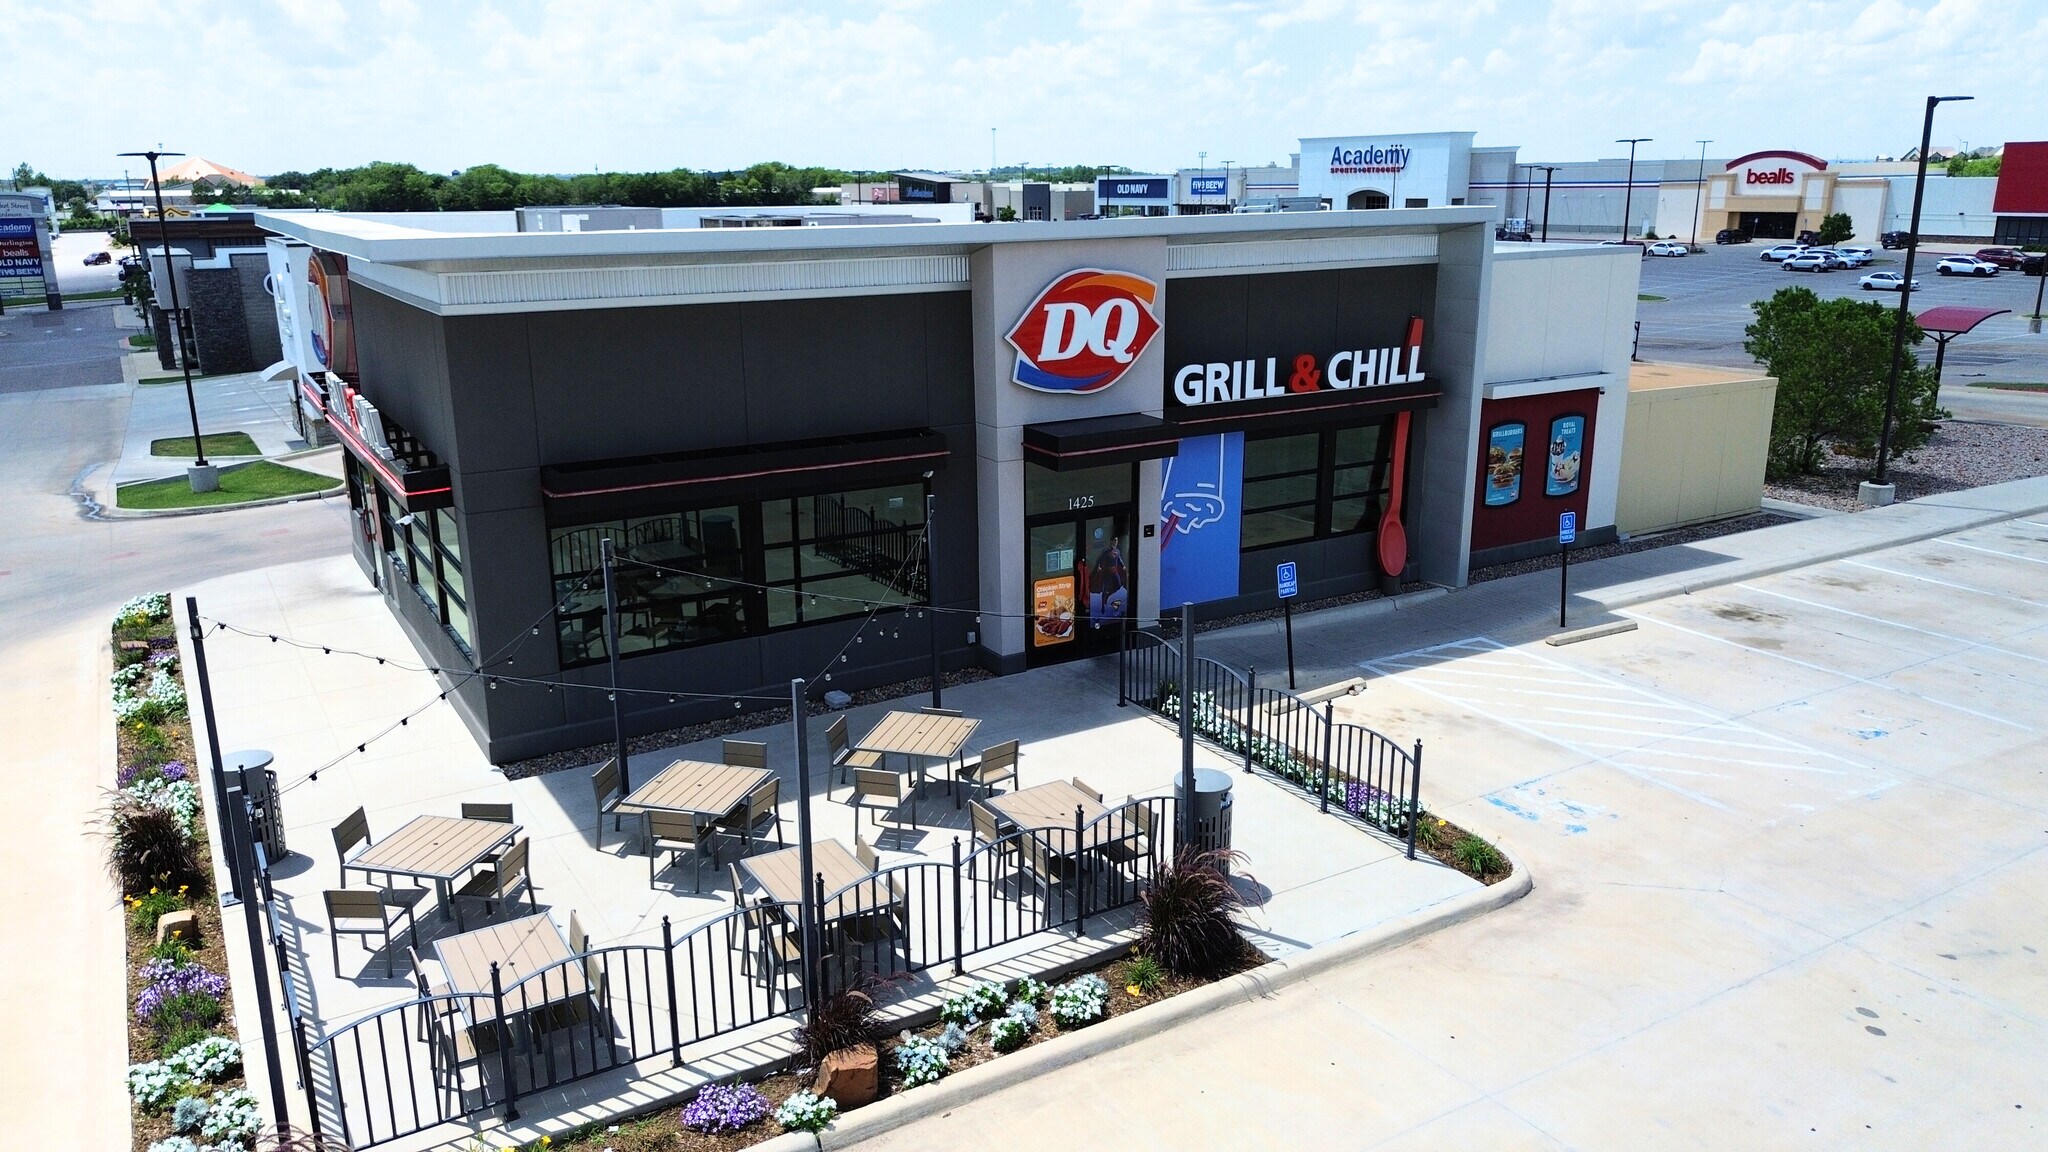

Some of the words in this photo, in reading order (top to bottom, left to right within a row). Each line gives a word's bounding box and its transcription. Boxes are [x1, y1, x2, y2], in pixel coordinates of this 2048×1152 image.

[1330, 144, 1411, 170] Academy
[1746, 168, 1794, 184] bealls
[1117, 184, 1129, 194] OLD
[1130, 184, 1149, 194] NAVY
[10, 202, 29, 210] Street
[0, 239, 34, 247] urlington
[3, 249, 29, 257] bealls
[15, 258, 40, 266] NAVY
[0, 268, 15, 276] ive
[1037, 297, 1140, 364] DQ
[1173, 356, 1285, 406] GRILL
[1288, 353, 1322, 394] &
[1326, 345, 1426, 391] CHILL
[1069, 495, 1095, 510] 1425
